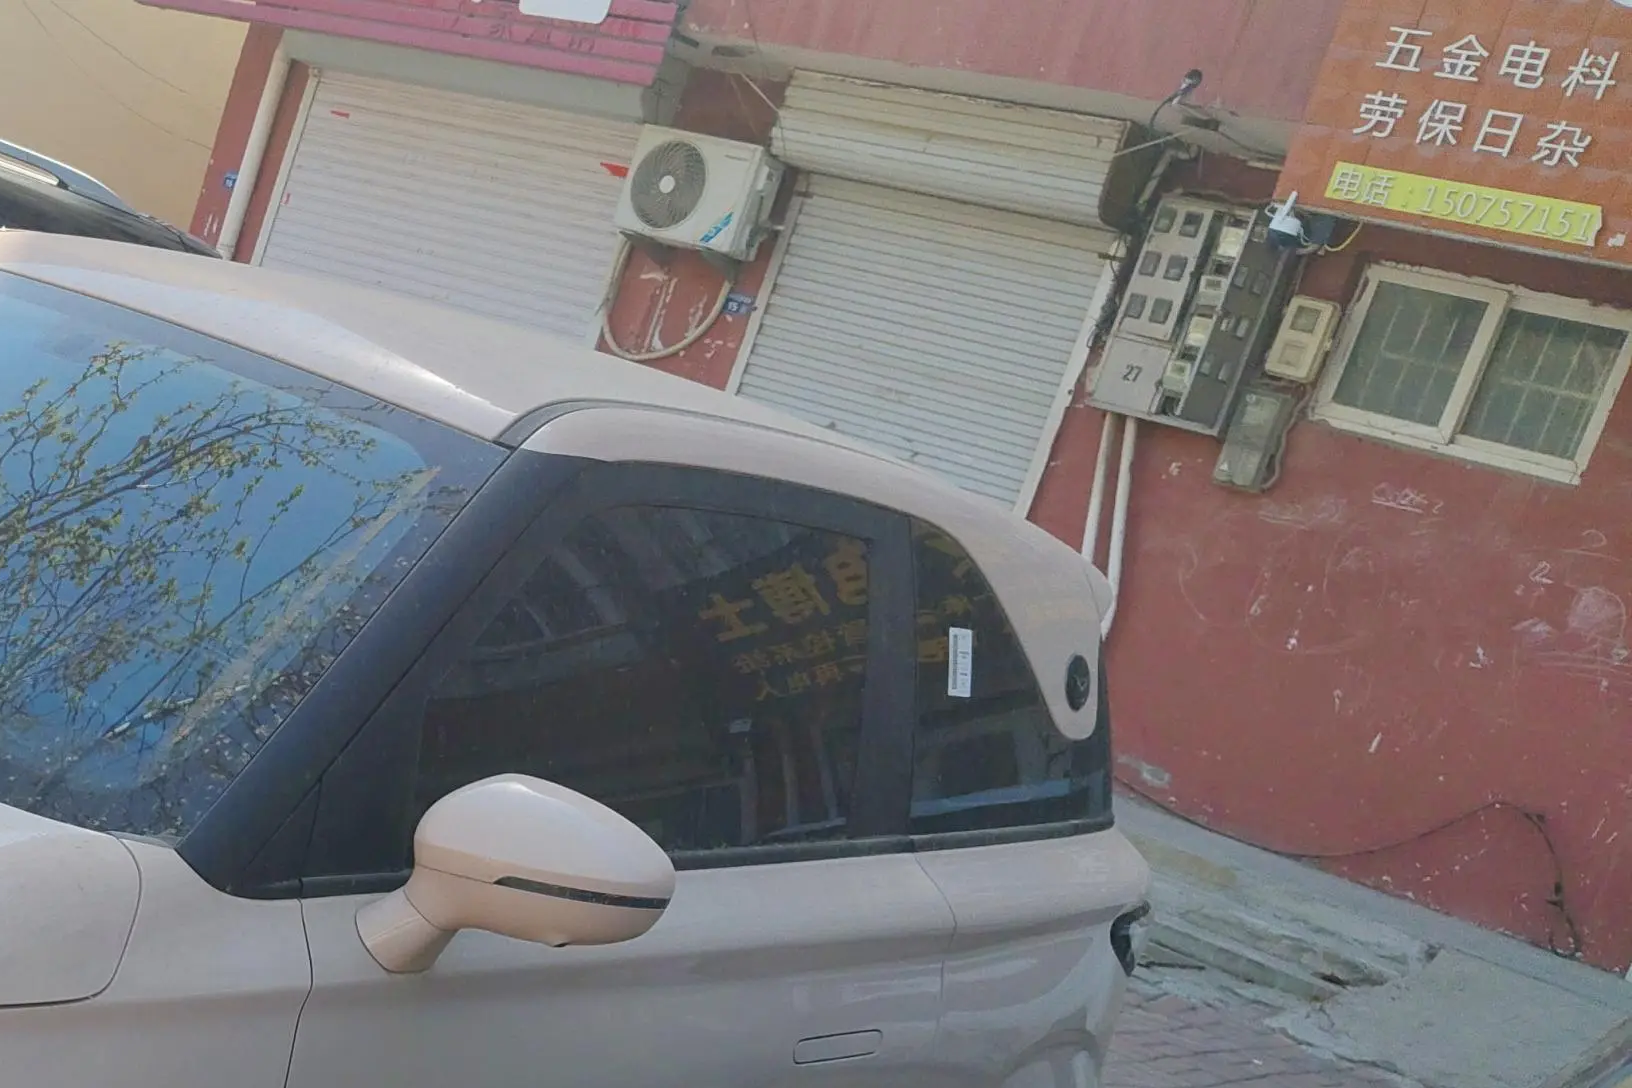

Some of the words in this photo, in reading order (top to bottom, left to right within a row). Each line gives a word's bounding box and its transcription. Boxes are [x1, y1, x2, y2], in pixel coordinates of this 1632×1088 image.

[1375, 25, 1620, 100] 五金电料
[1352, 90, 1593, 168] 劳保日杂
[1122, 363, 1143, 382] 27
